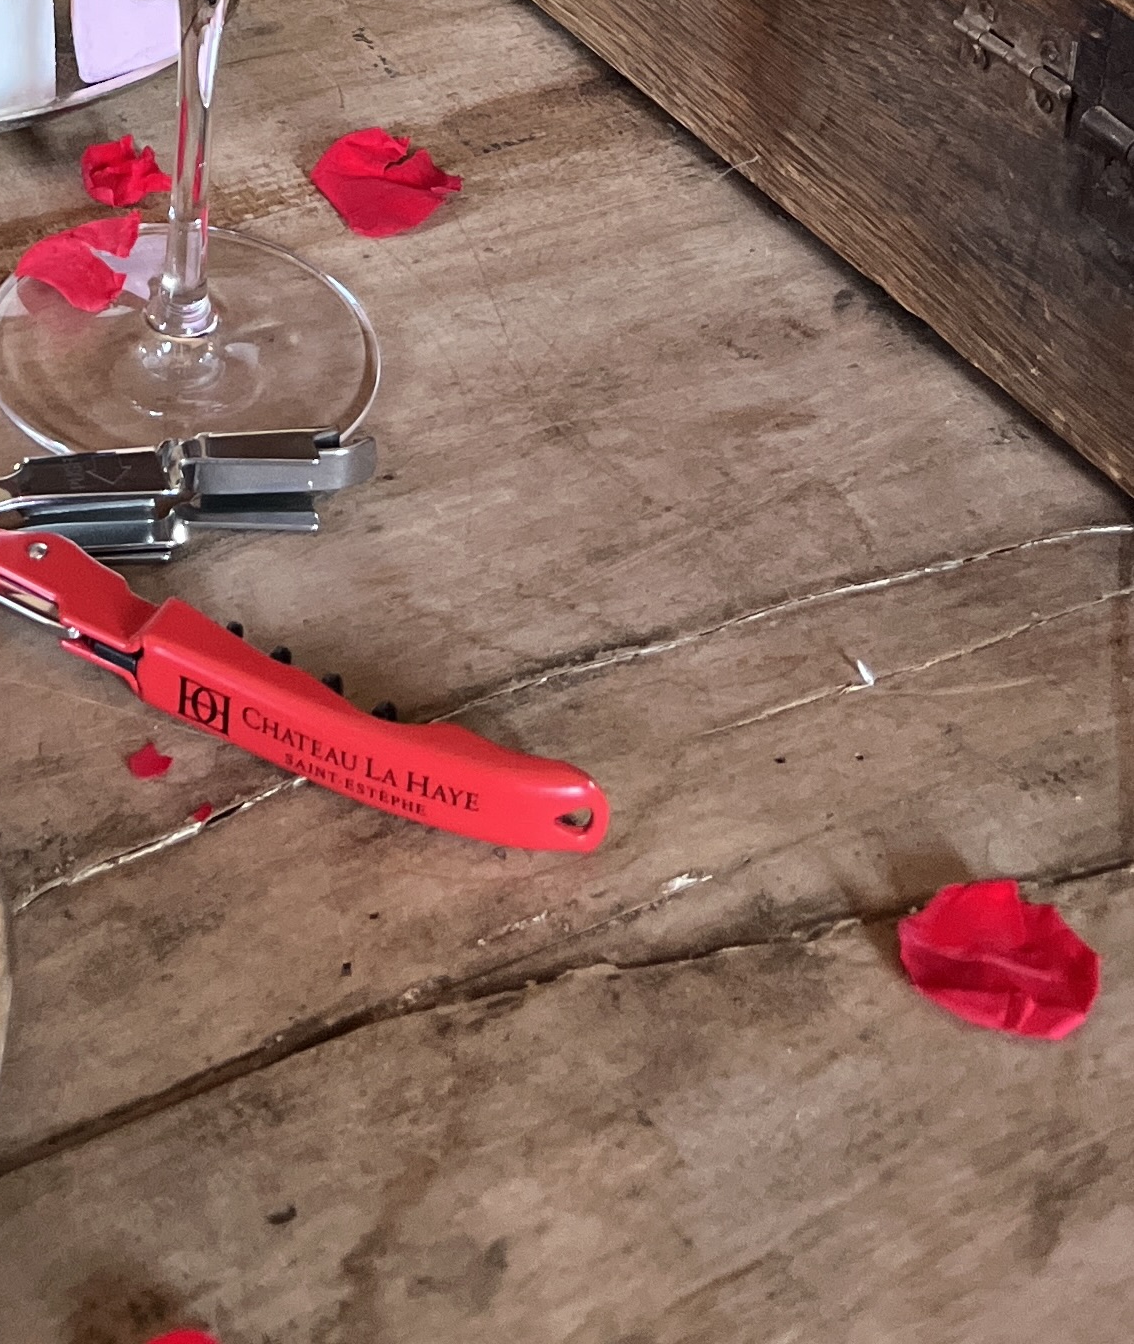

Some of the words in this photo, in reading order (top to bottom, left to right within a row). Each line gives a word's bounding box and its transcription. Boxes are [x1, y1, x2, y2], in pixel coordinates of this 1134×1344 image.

[242, 705, 358, 771] CHATEAU
[365, 755, 398, 789] LA
[405, 770, 480, 813] HAYE
